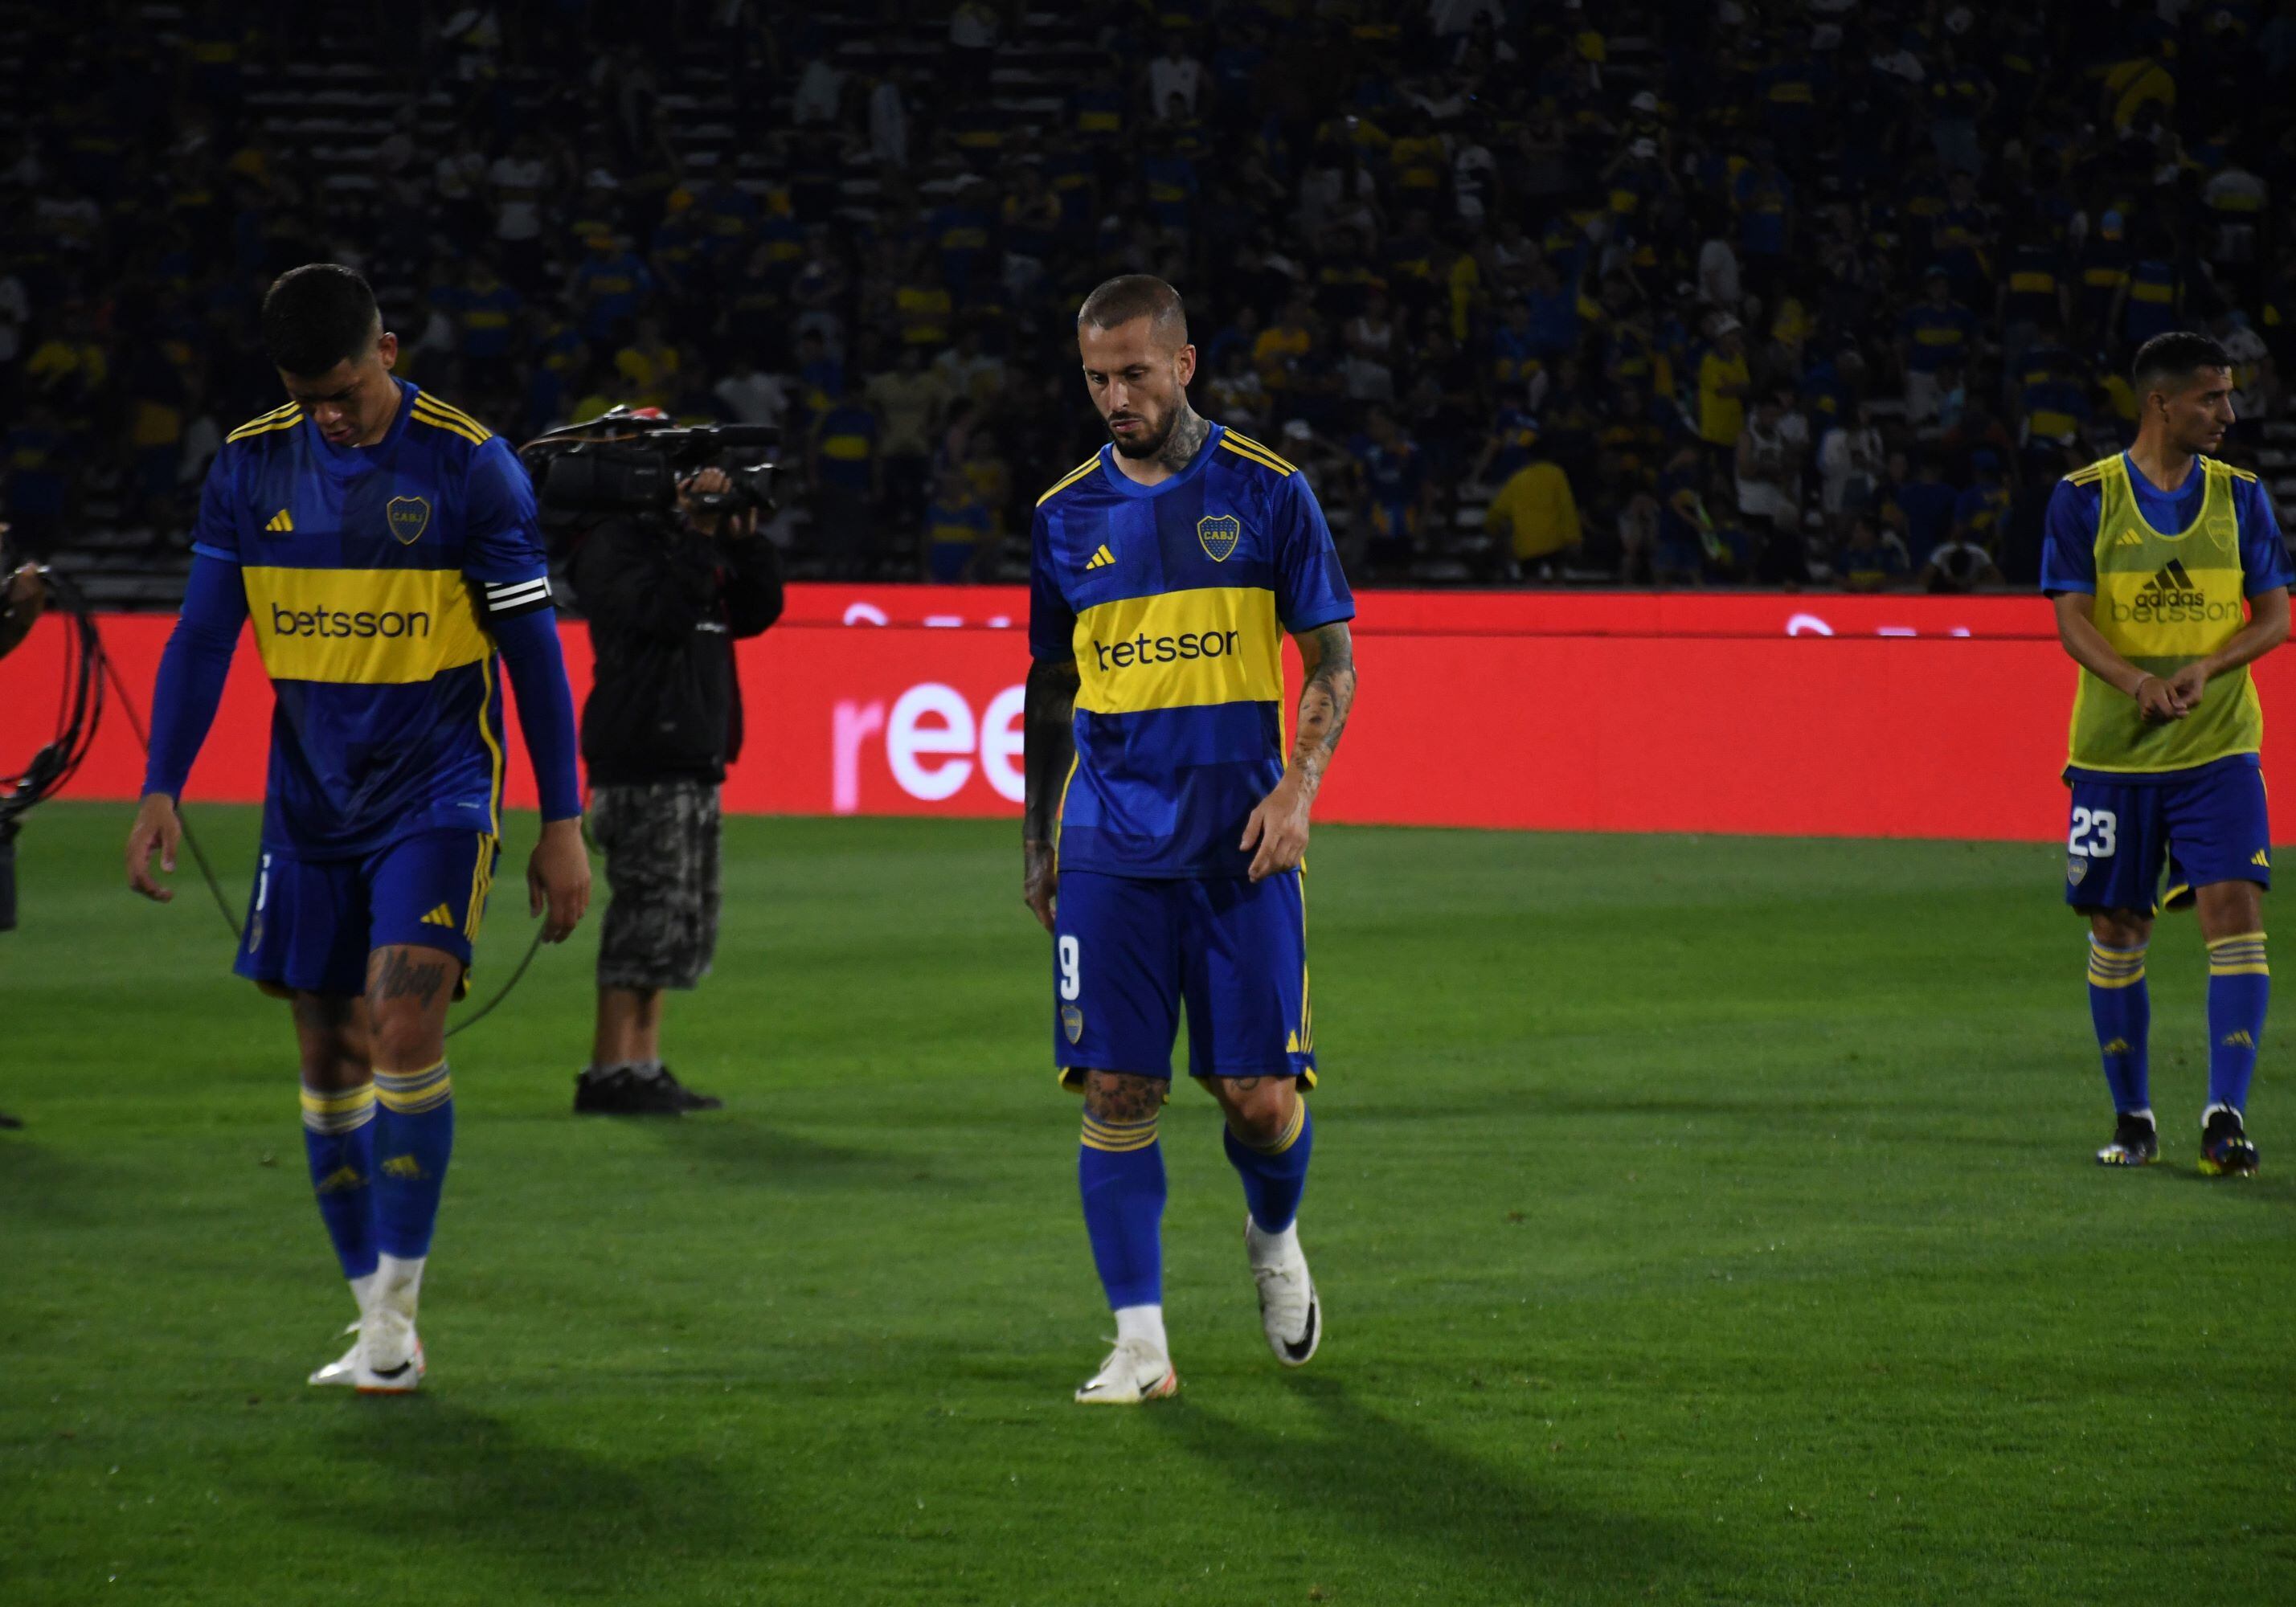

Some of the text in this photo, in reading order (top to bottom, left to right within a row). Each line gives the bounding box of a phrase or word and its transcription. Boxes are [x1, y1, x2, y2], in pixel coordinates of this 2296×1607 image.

[1204, 531, 1234, 541] CABJ
[2110, 596, 2238, 624] betsson
[2134, 589, 2204, 607] adidas
[272, 602, 428, 638] betsson
[2069, 806, 2117, 858] 23
[1058, 934, 1080, 1001] 9
